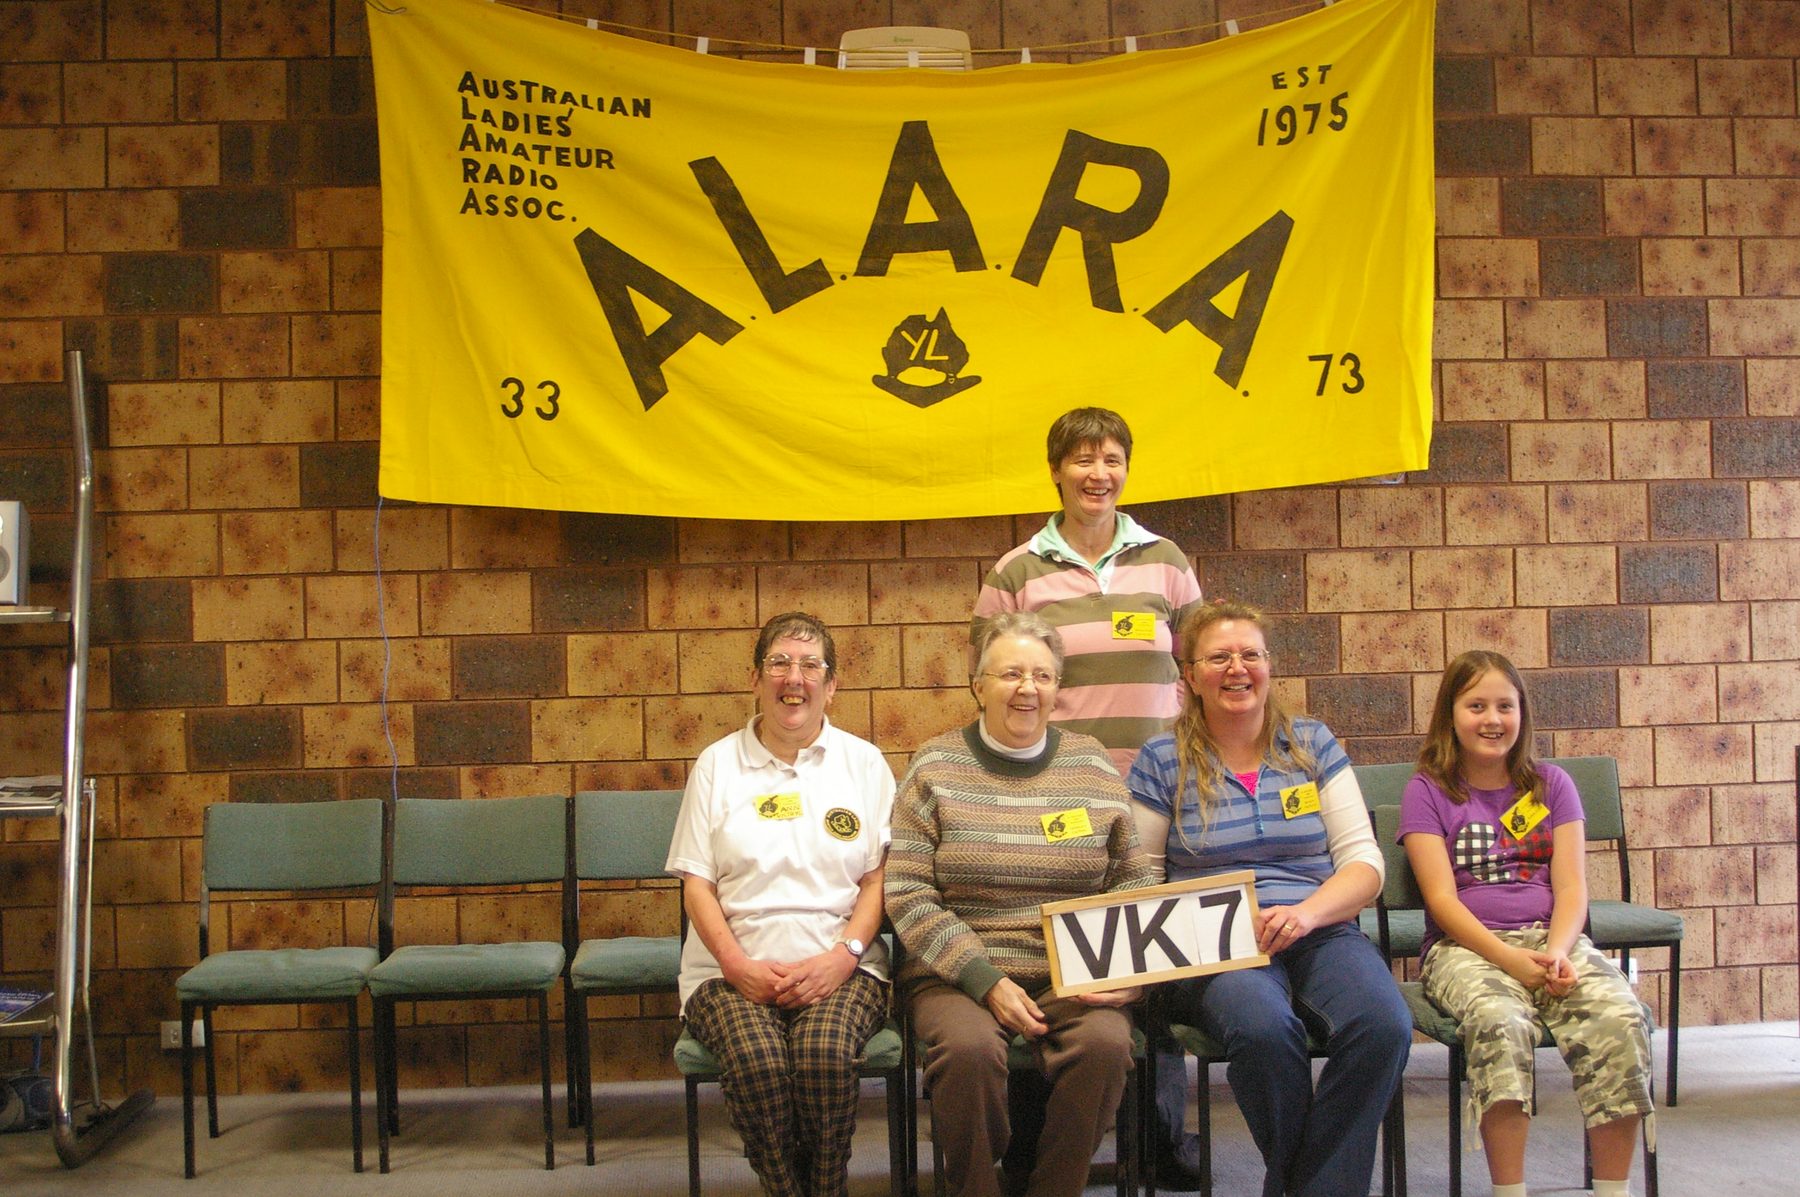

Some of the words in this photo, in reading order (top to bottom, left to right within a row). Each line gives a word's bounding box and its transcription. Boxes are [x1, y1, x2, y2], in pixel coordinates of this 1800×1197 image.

[457, 70, 652, 119] AUSTRALIAN
[1271, 64, 1333, 90] EST
[1257, 91, 1349, 147] 1975
[458, 123, 616, 170] AMATEUR
[461, 158, 559, 191] RADIO
[459, 188, 578, 223] ASSOC.
[900, 329, 950, 361] YL
[1307, 352, 1365, 397] 73
[500, 377, 561, 421] 33
[1059, 897, 1193, 980] VK
[1198, 889, 1242, 962] 7
